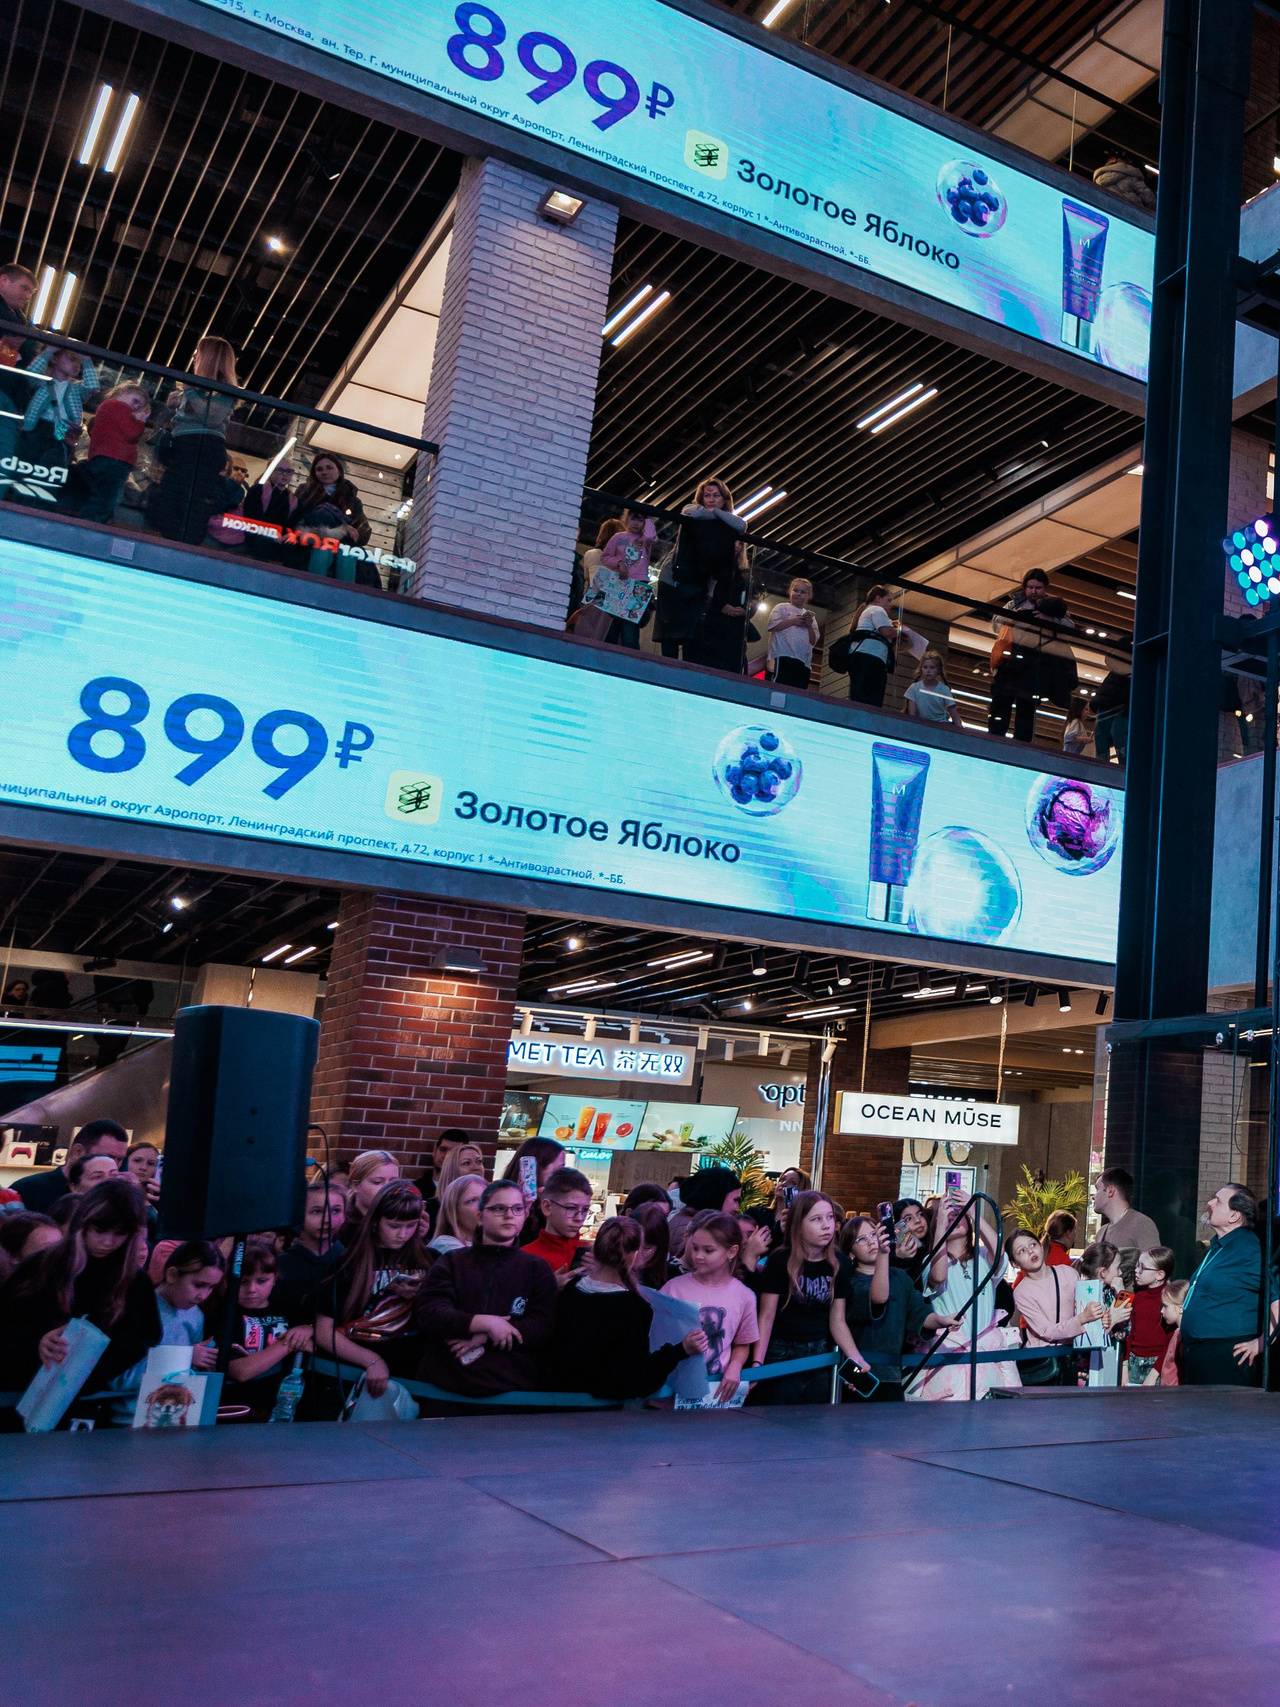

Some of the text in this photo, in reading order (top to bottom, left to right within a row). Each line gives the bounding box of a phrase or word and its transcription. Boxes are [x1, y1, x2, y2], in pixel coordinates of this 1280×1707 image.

[321, 37, 339, 50] вн.
[343, 43, 366, 62] Тер.
[381, 61, 477, 105] муниципальный
[480, 101, 510, 118] округ
[512, 113, 565, 142] Аэропорт,
[568, 136, 647, 174] Ленинградский
[650, 169, 695, 195] проспект,
[722, 199, 753, 219] корпус
[737, 158, 960, 270] Золотое Яблоко
[111, 799, 151, 815] округ
[154, 804, 225, 826] Аэропорт,
[228, 816, 334, 840] Ленинградский
[337, 833, 398, 852] проспект,
[433, 848, 475, 864] корпус
[454, 790, 742, 864] Золотое Яблоко
[562, 1045, 605, 1067] TEA
[617, 1050, 683, 1073] 茶无双
[861, 1103, 1002, 1128] OCEAN MŪSE
